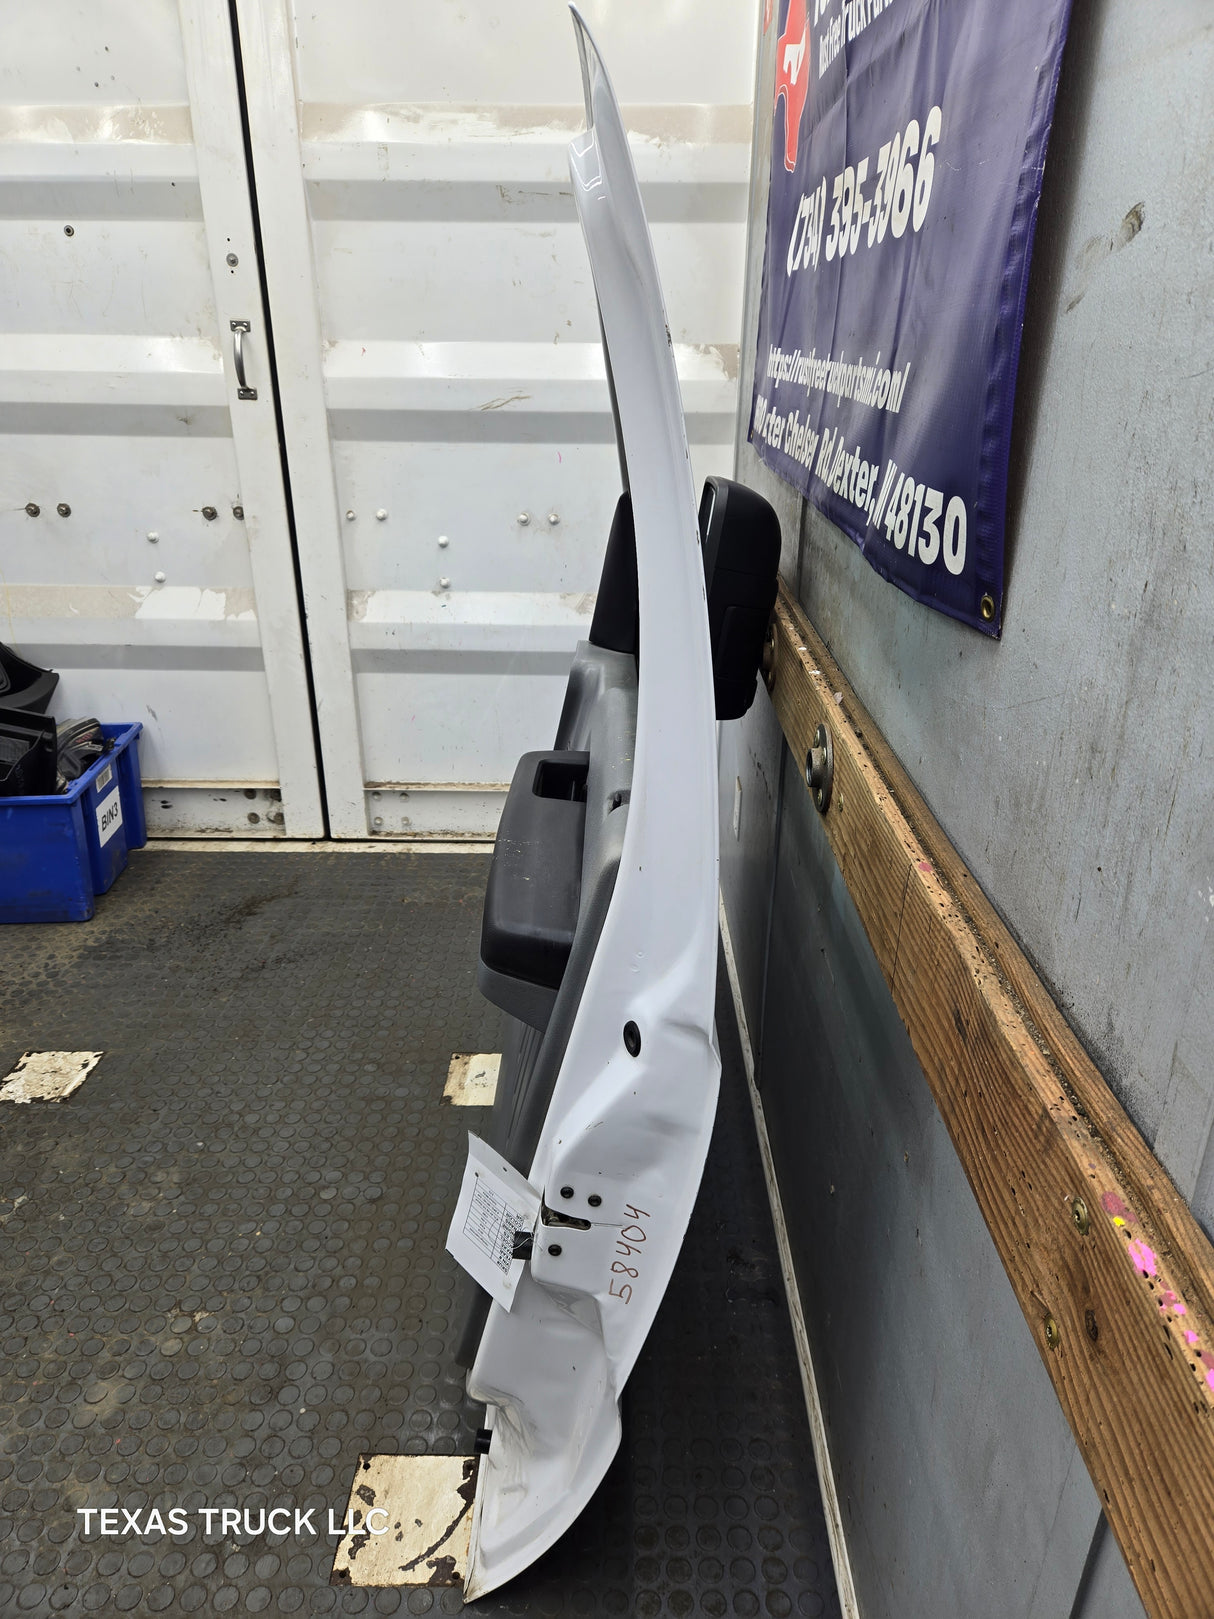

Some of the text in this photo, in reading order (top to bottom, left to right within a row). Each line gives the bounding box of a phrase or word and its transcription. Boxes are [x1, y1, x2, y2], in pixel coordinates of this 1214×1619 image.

[786, 105, 942, 277] (734) 395-3966
[884, 472, 967, 575] 48130
[101, 802, 119, 832] BIN3
[608, 1203, 651, 1305] 58404
